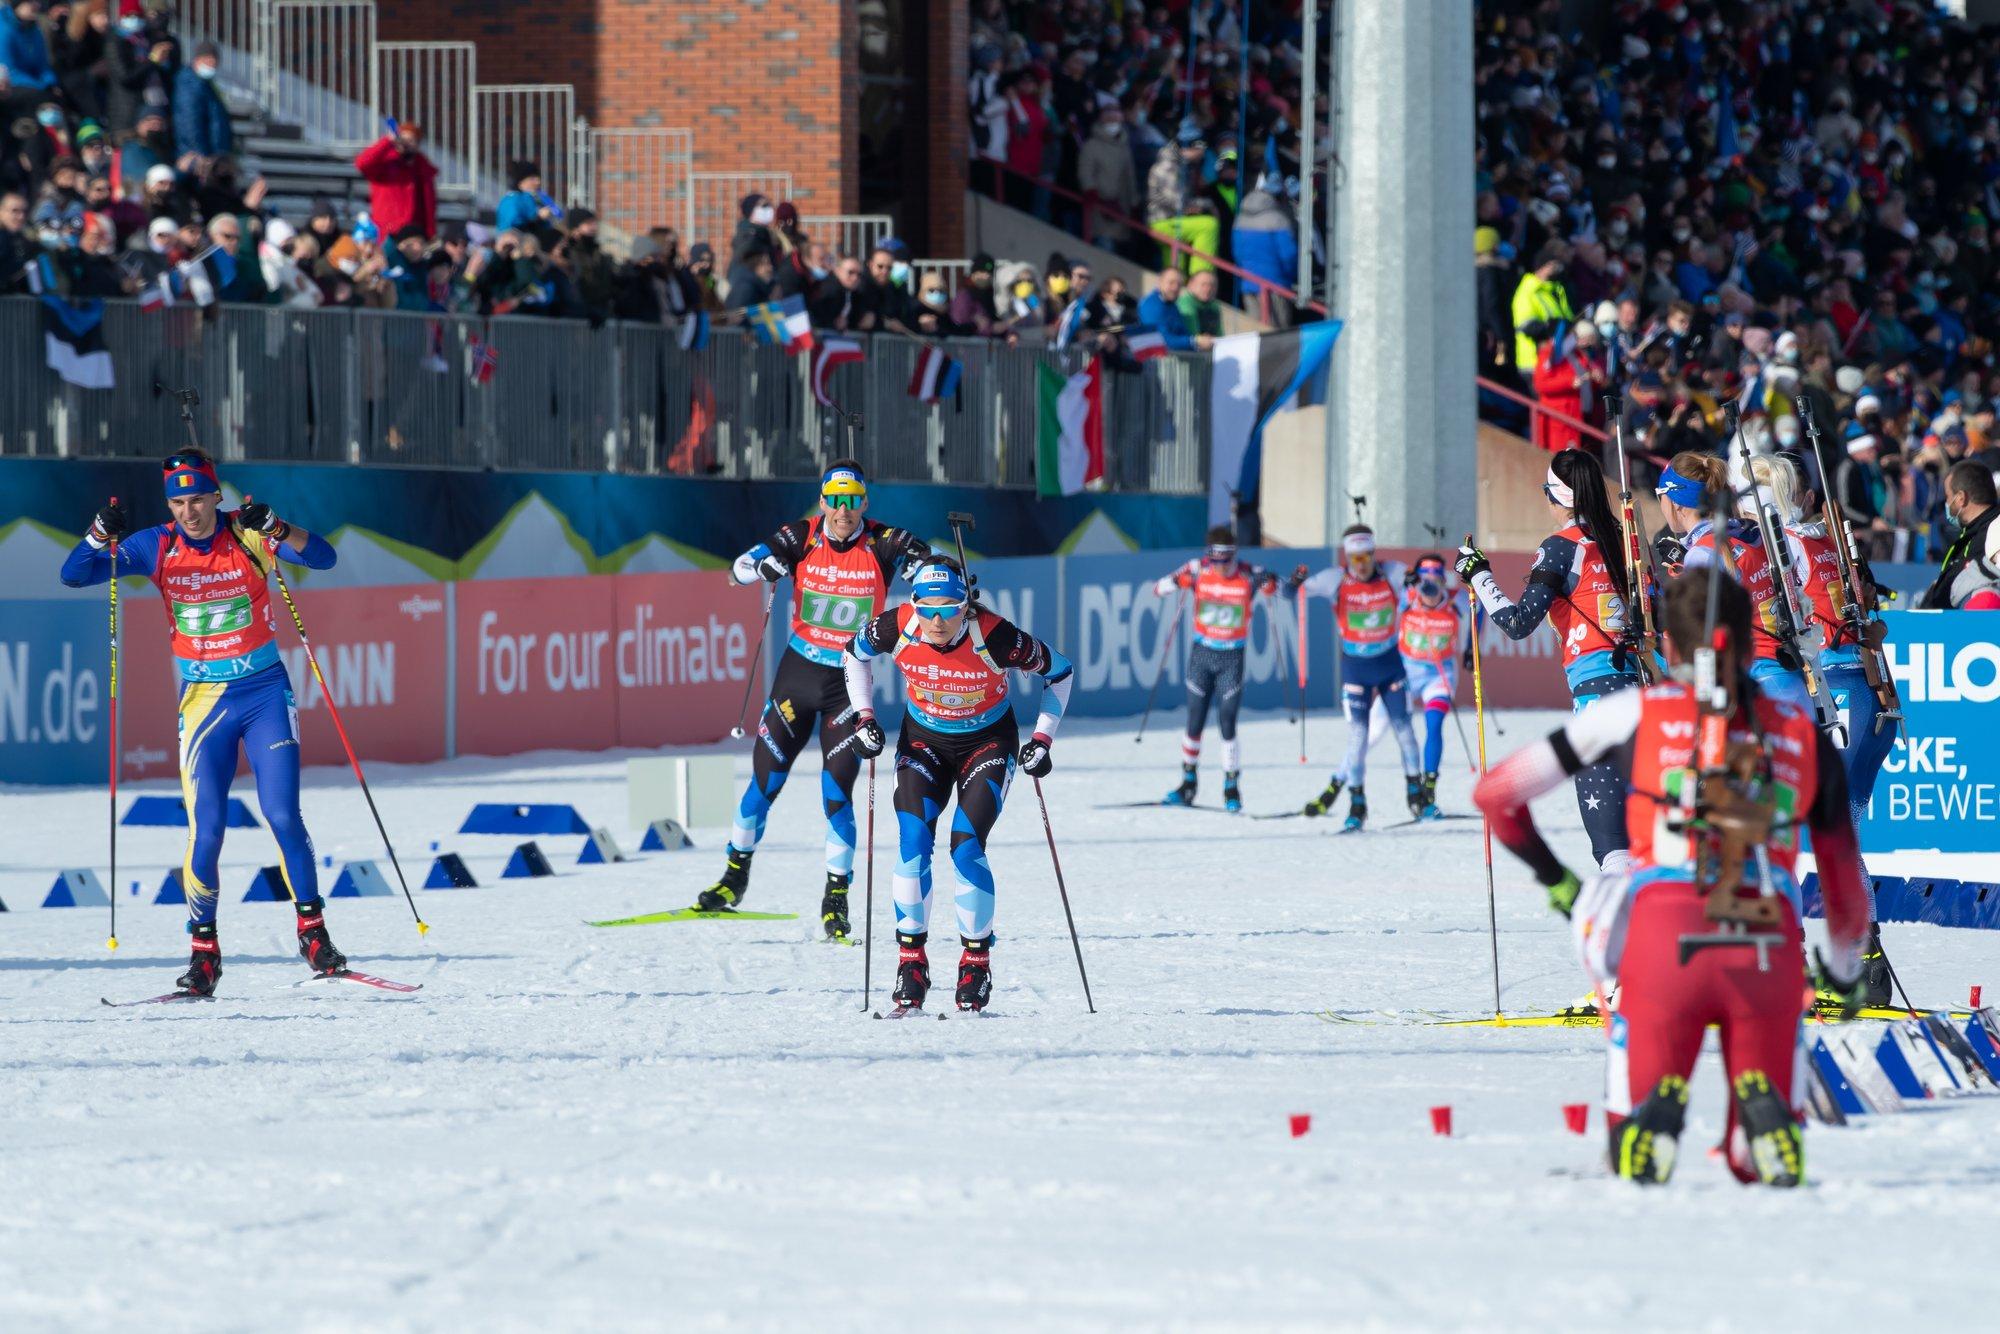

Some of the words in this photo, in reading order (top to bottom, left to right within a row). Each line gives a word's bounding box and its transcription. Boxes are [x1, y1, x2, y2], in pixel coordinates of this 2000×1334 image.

[167, 569, 243, 590] VIESSMANN
[806, 564, 875, 583] VIESSMANN
[168, 589, 181, 600] for
[184, 592, 203, 601] our
[205, 585, 248, 599] climate
[803, 577, 816, 588] for
[818, 584, 835, 593] our
[838, 583, 875, 595] climate
[178, 603, 232, 631] 17
[811, 597, 857, 626] 10
[478, 610, 537, 695] for
[545, 631, 608, 692] our
[617, 604, 747, 689] climate
[900, 661, 988, 681] VIESSMANN
[919, 681, 940, 690] our
[943, 681, 989, 692] climate
[827, 733, 858, 760] moom
[1889, 783, 2000, 821] BEWE
